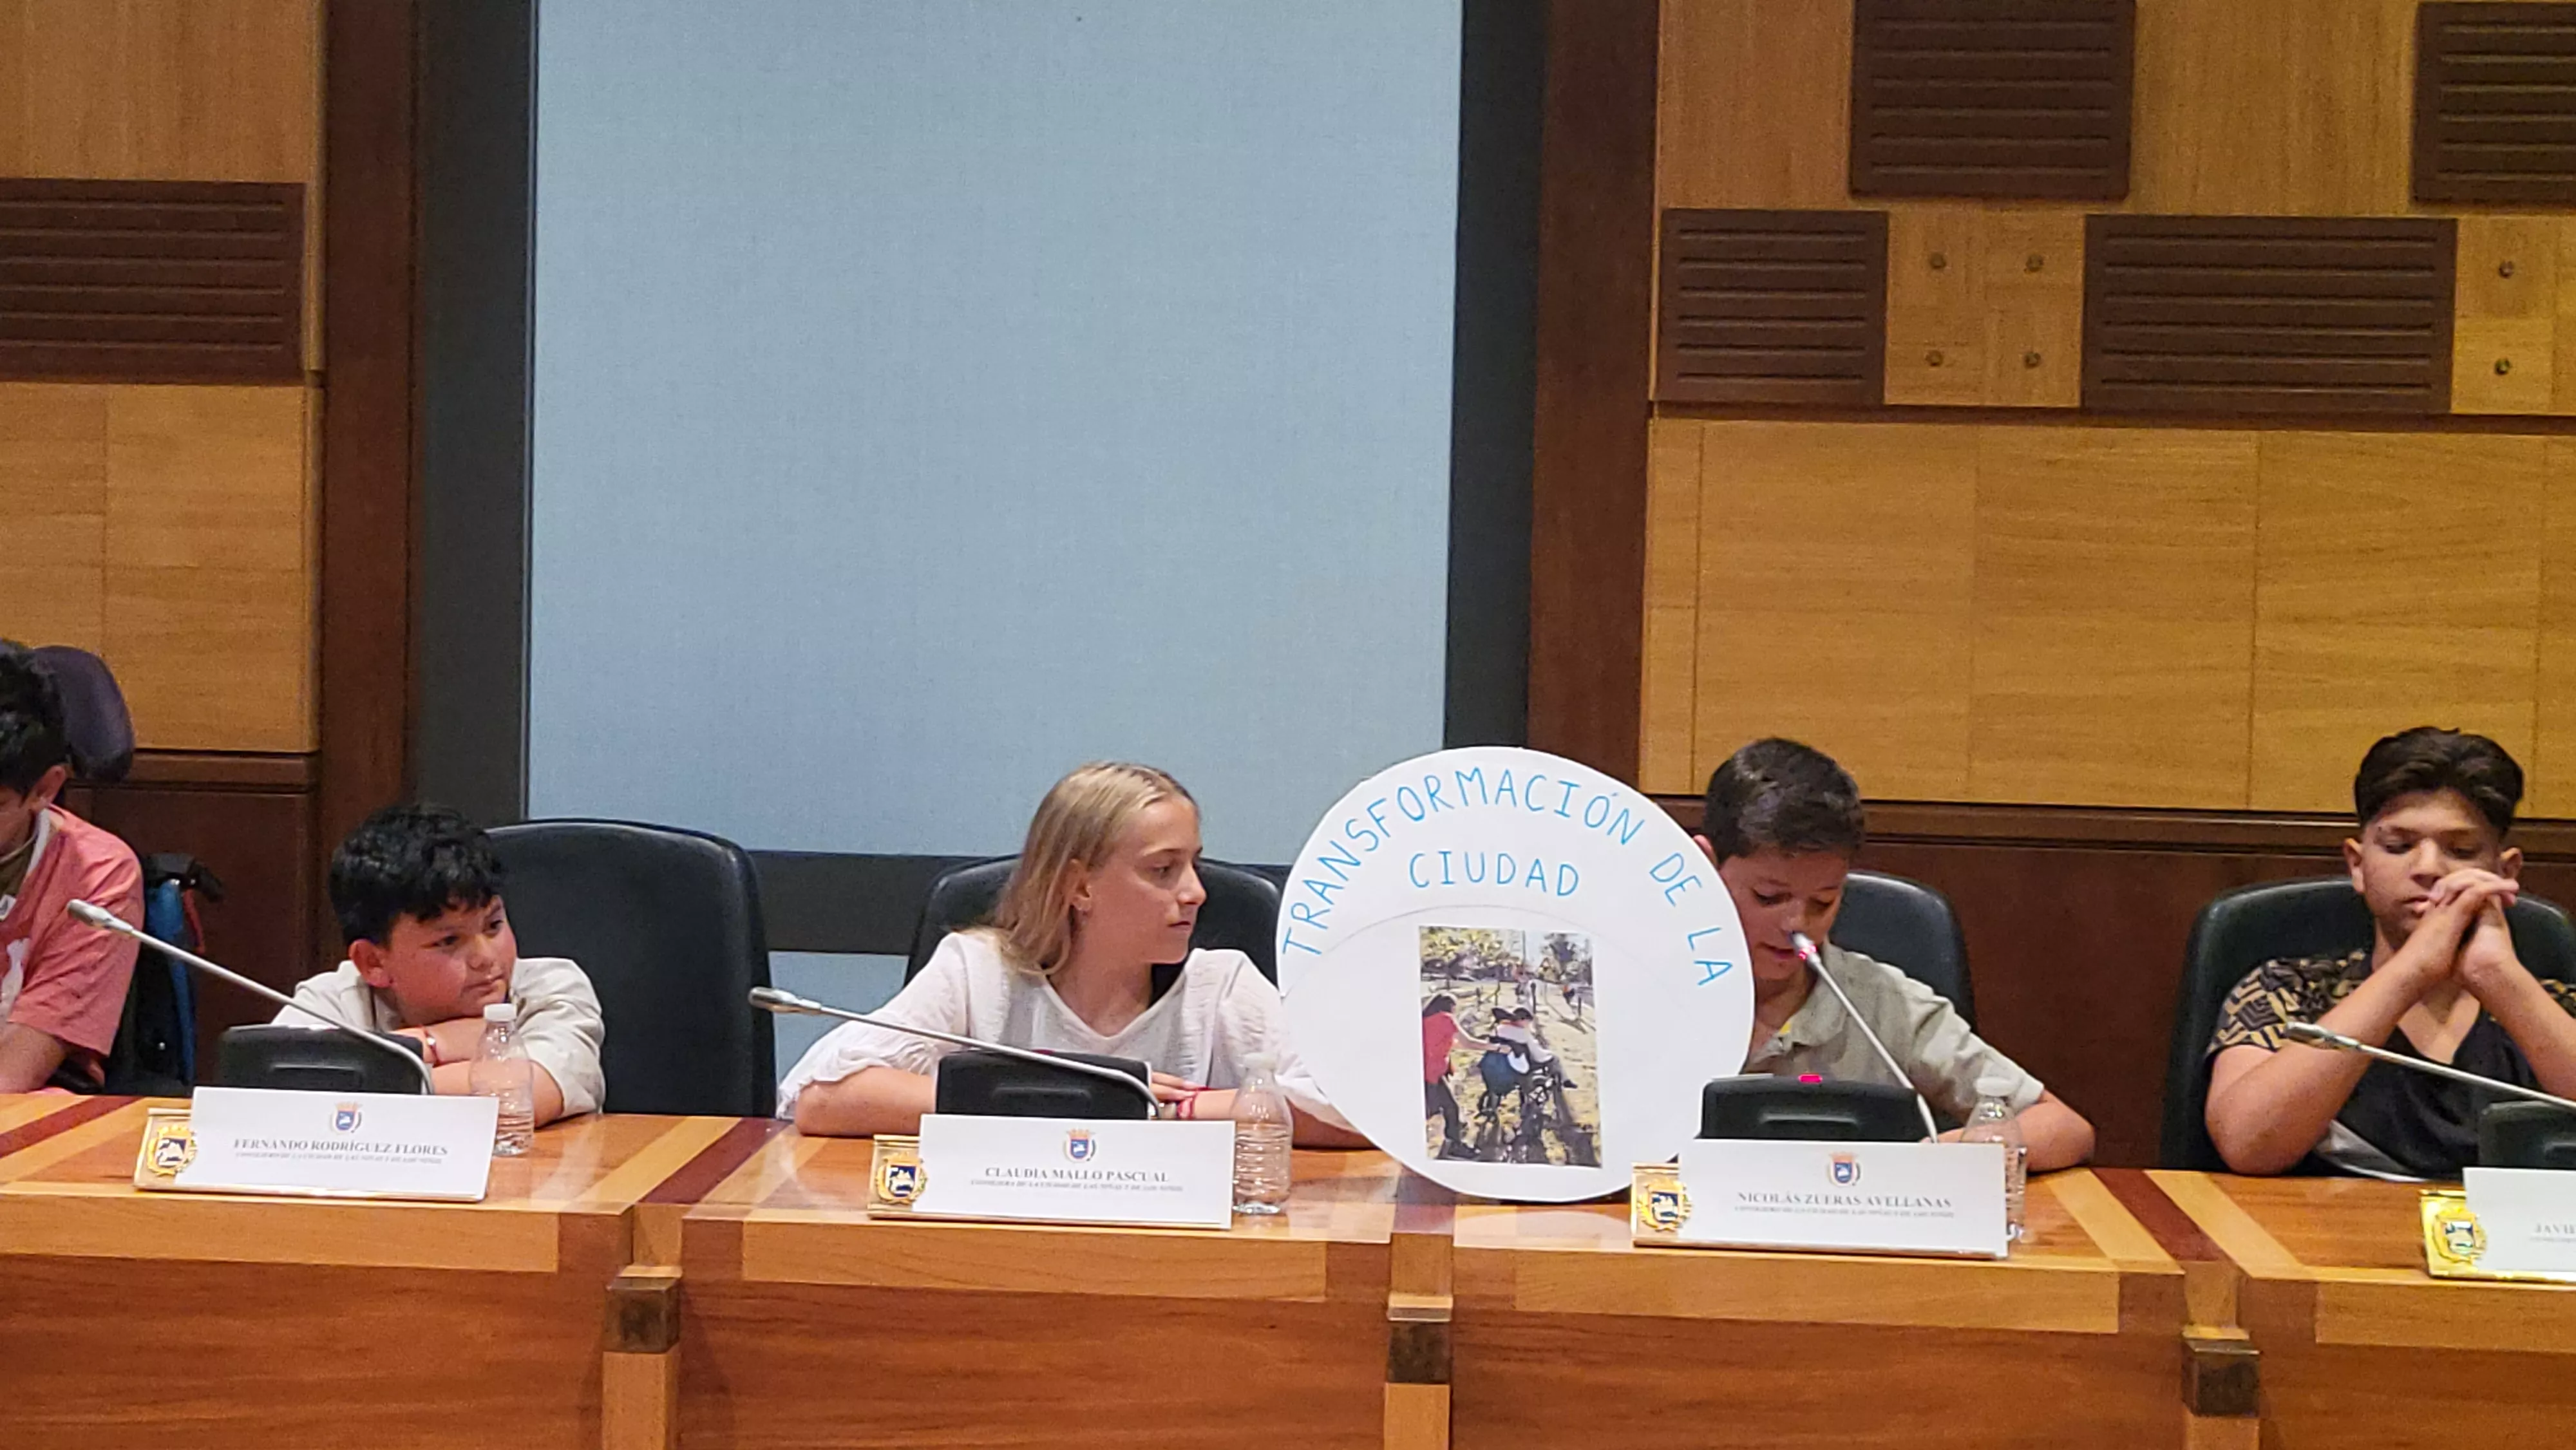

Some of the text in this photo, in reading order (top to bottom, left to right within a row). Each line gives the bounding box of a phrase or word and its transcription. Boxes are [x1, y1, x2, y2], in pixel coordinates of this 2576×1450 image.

[1282, 767, 1732, 986] TRANSFORMACIÓN DE LA
[1410, 851, 1578, 896] CIUDAD
[233, 1138, 448, 1156] FERNANDO RODRÍGUEZ FLORES
[985, 1167, 1170, 1183] CLAUDIA MALLO PASCUAL
[1738, 1190, 1801, 1204] NICOLÁS
[1866, 1196, 1953, 1209] AVELLANAS
